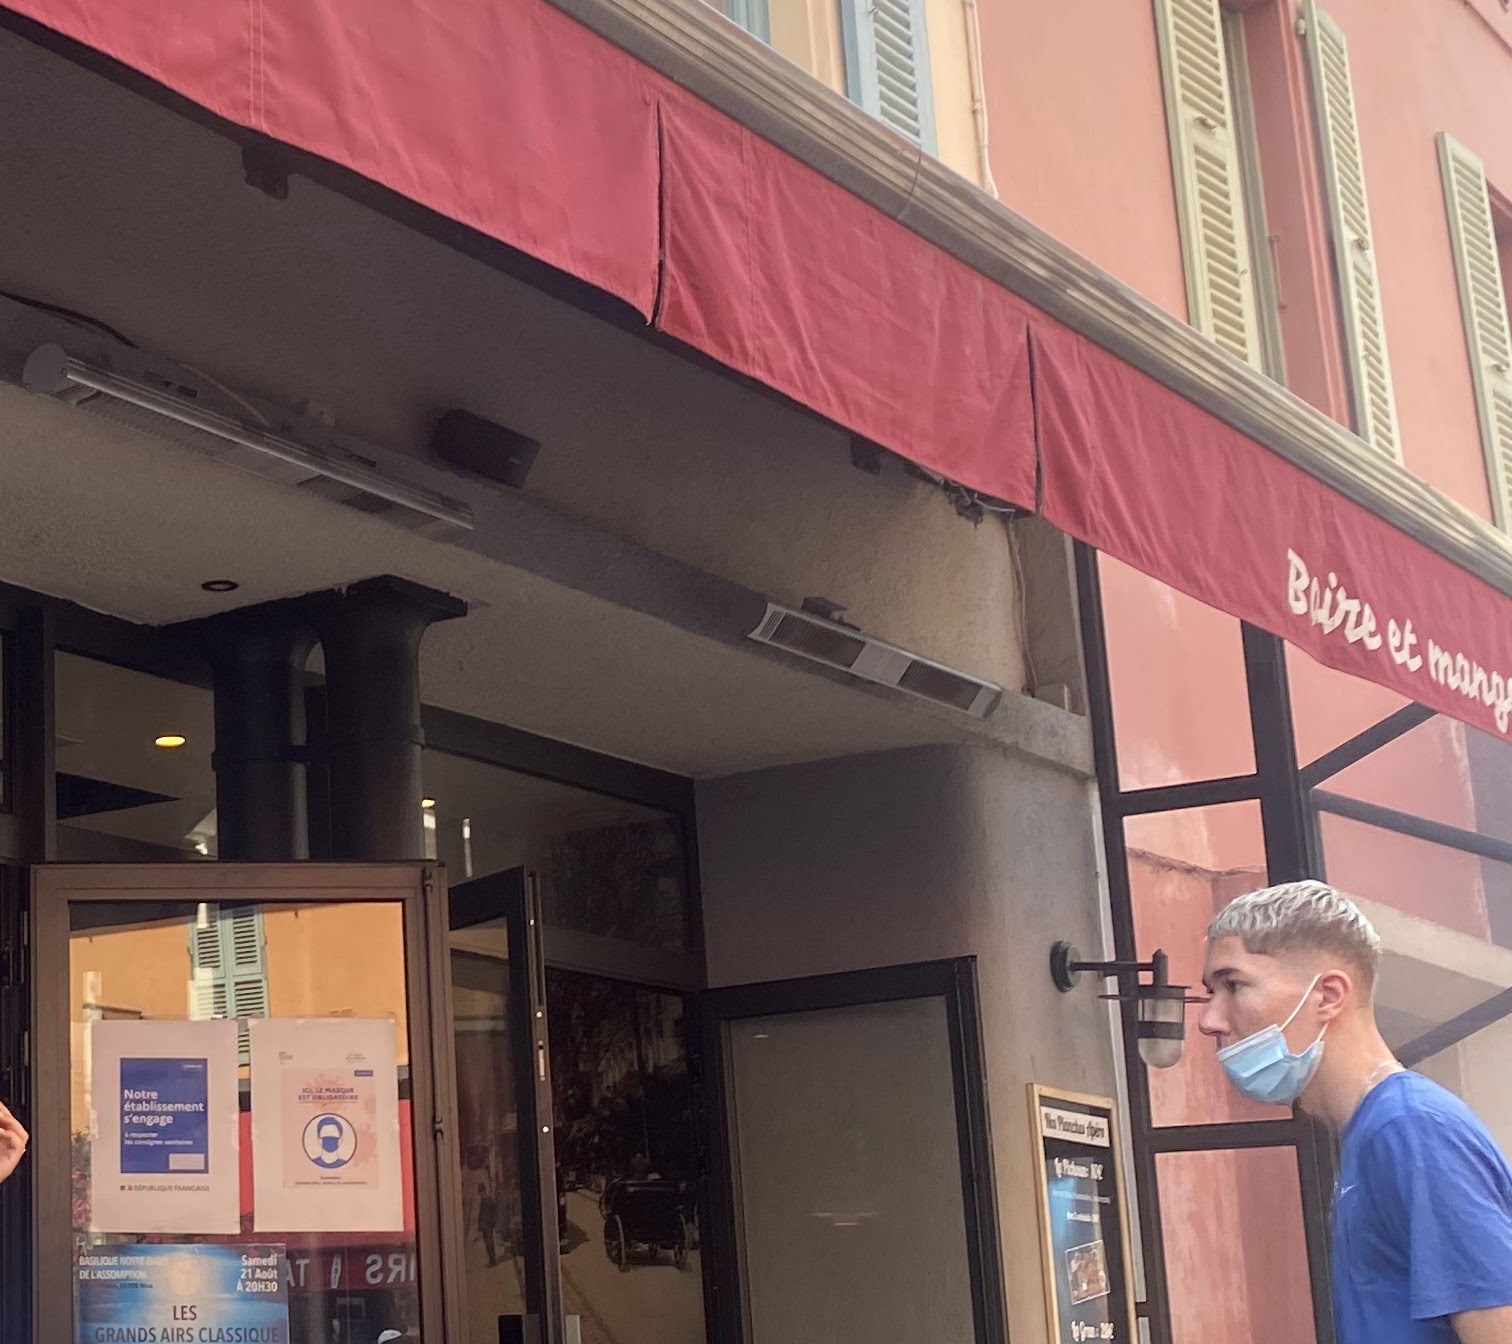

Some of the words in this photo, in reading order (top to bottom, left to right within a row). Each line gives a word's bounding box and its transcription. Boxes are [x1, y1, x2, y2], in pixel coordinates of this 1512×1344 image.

[1287, 548, 1382, 651] Boire
[1388, 618, 1423, 672] et
[123, 1089, 158, 1100] Notre
[123, 1101, 205, 1112] établissement
[123, 1113, 174, 1126] s'engage
[241, 1254, 278, 1266] Samedi
[240, 1268, 252, 1279] 21
[254, 1267, 278, 1280] Août
[245, 1280, 278, 1292] 20H30
[172, 1305, 198, 1321] LES
[95, 1327, 157, 1344] GRANDS
[160, 1327, 194, 1344] AIRS
[198, 1326, 280, 1344] CLASSIQUE
